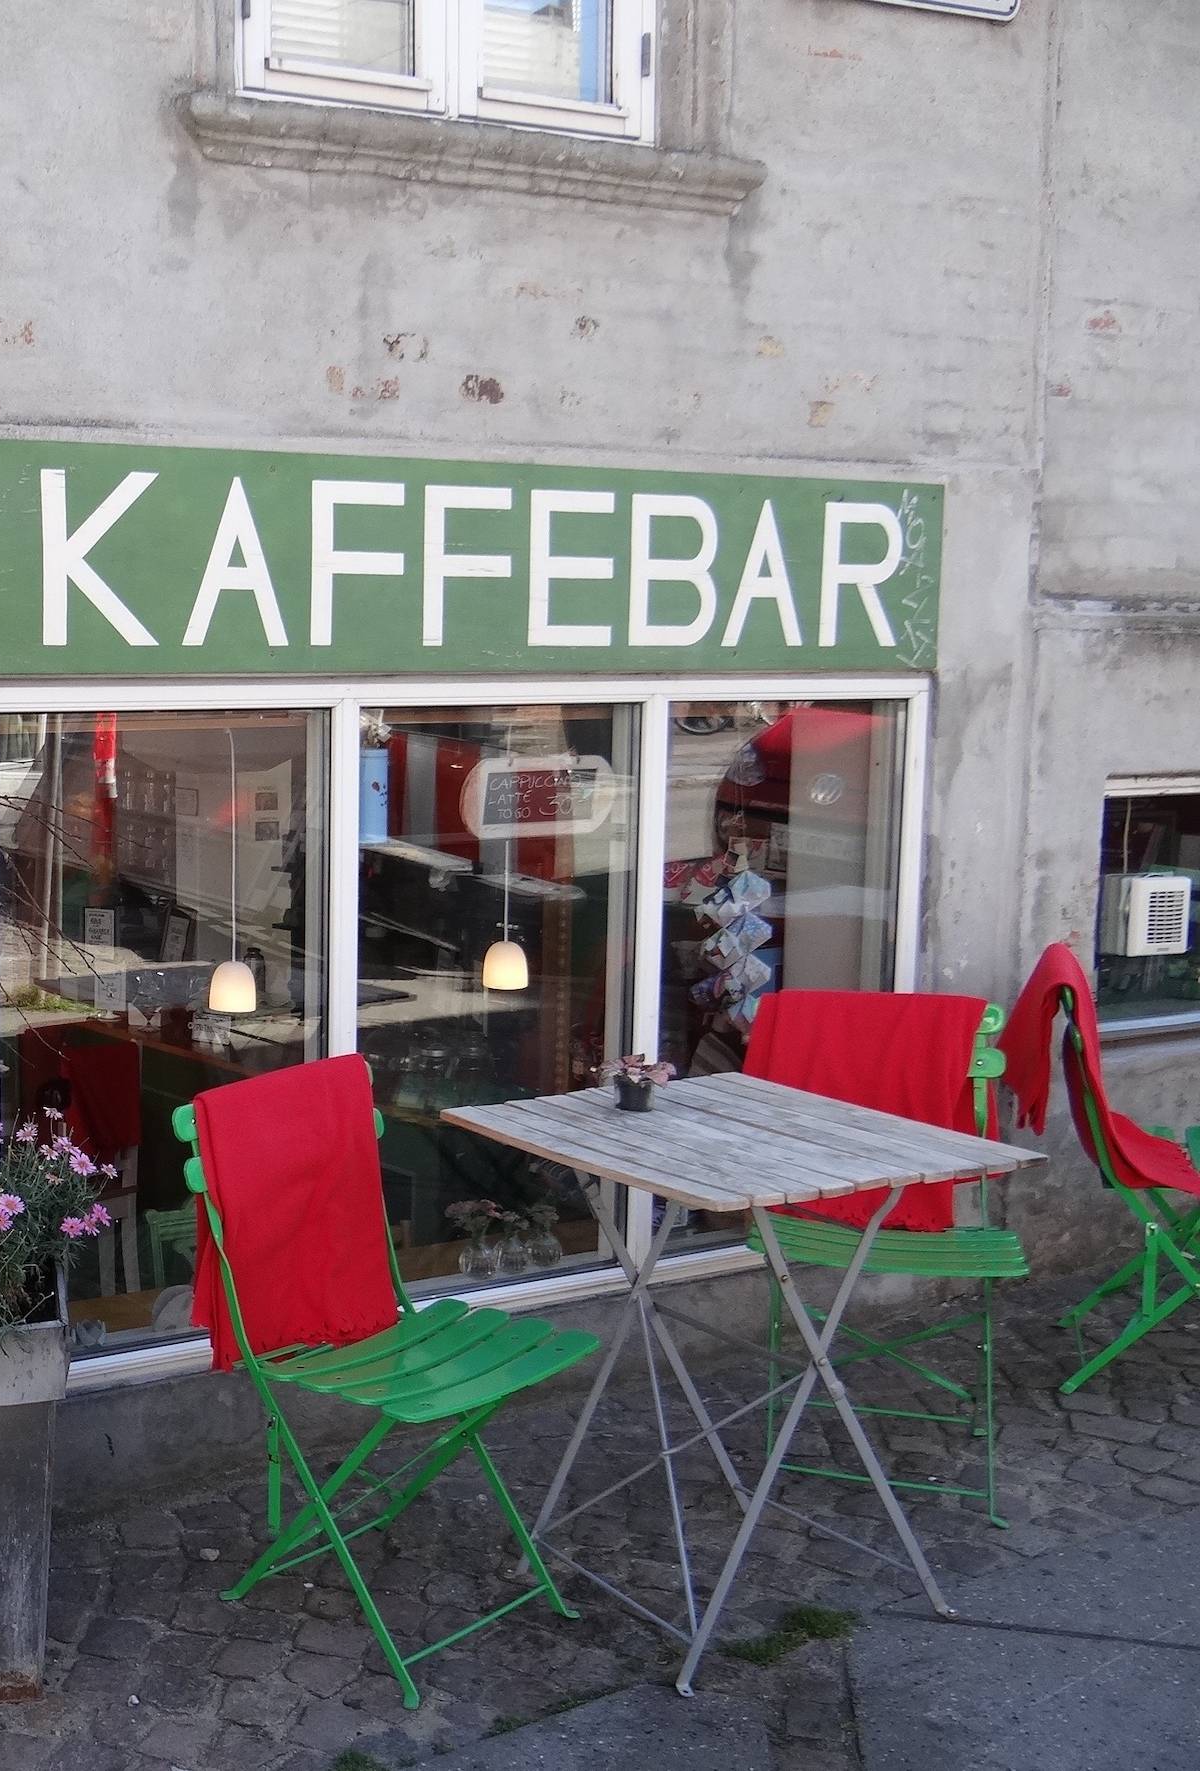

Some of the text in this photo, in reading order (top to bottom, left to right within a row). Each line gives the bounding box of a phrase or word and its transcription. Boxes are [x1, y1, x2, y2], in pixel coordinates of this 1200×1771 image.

[39, 468, 904, 649] KAFFEBAR
[496, 806, 532, 819] TO GO
